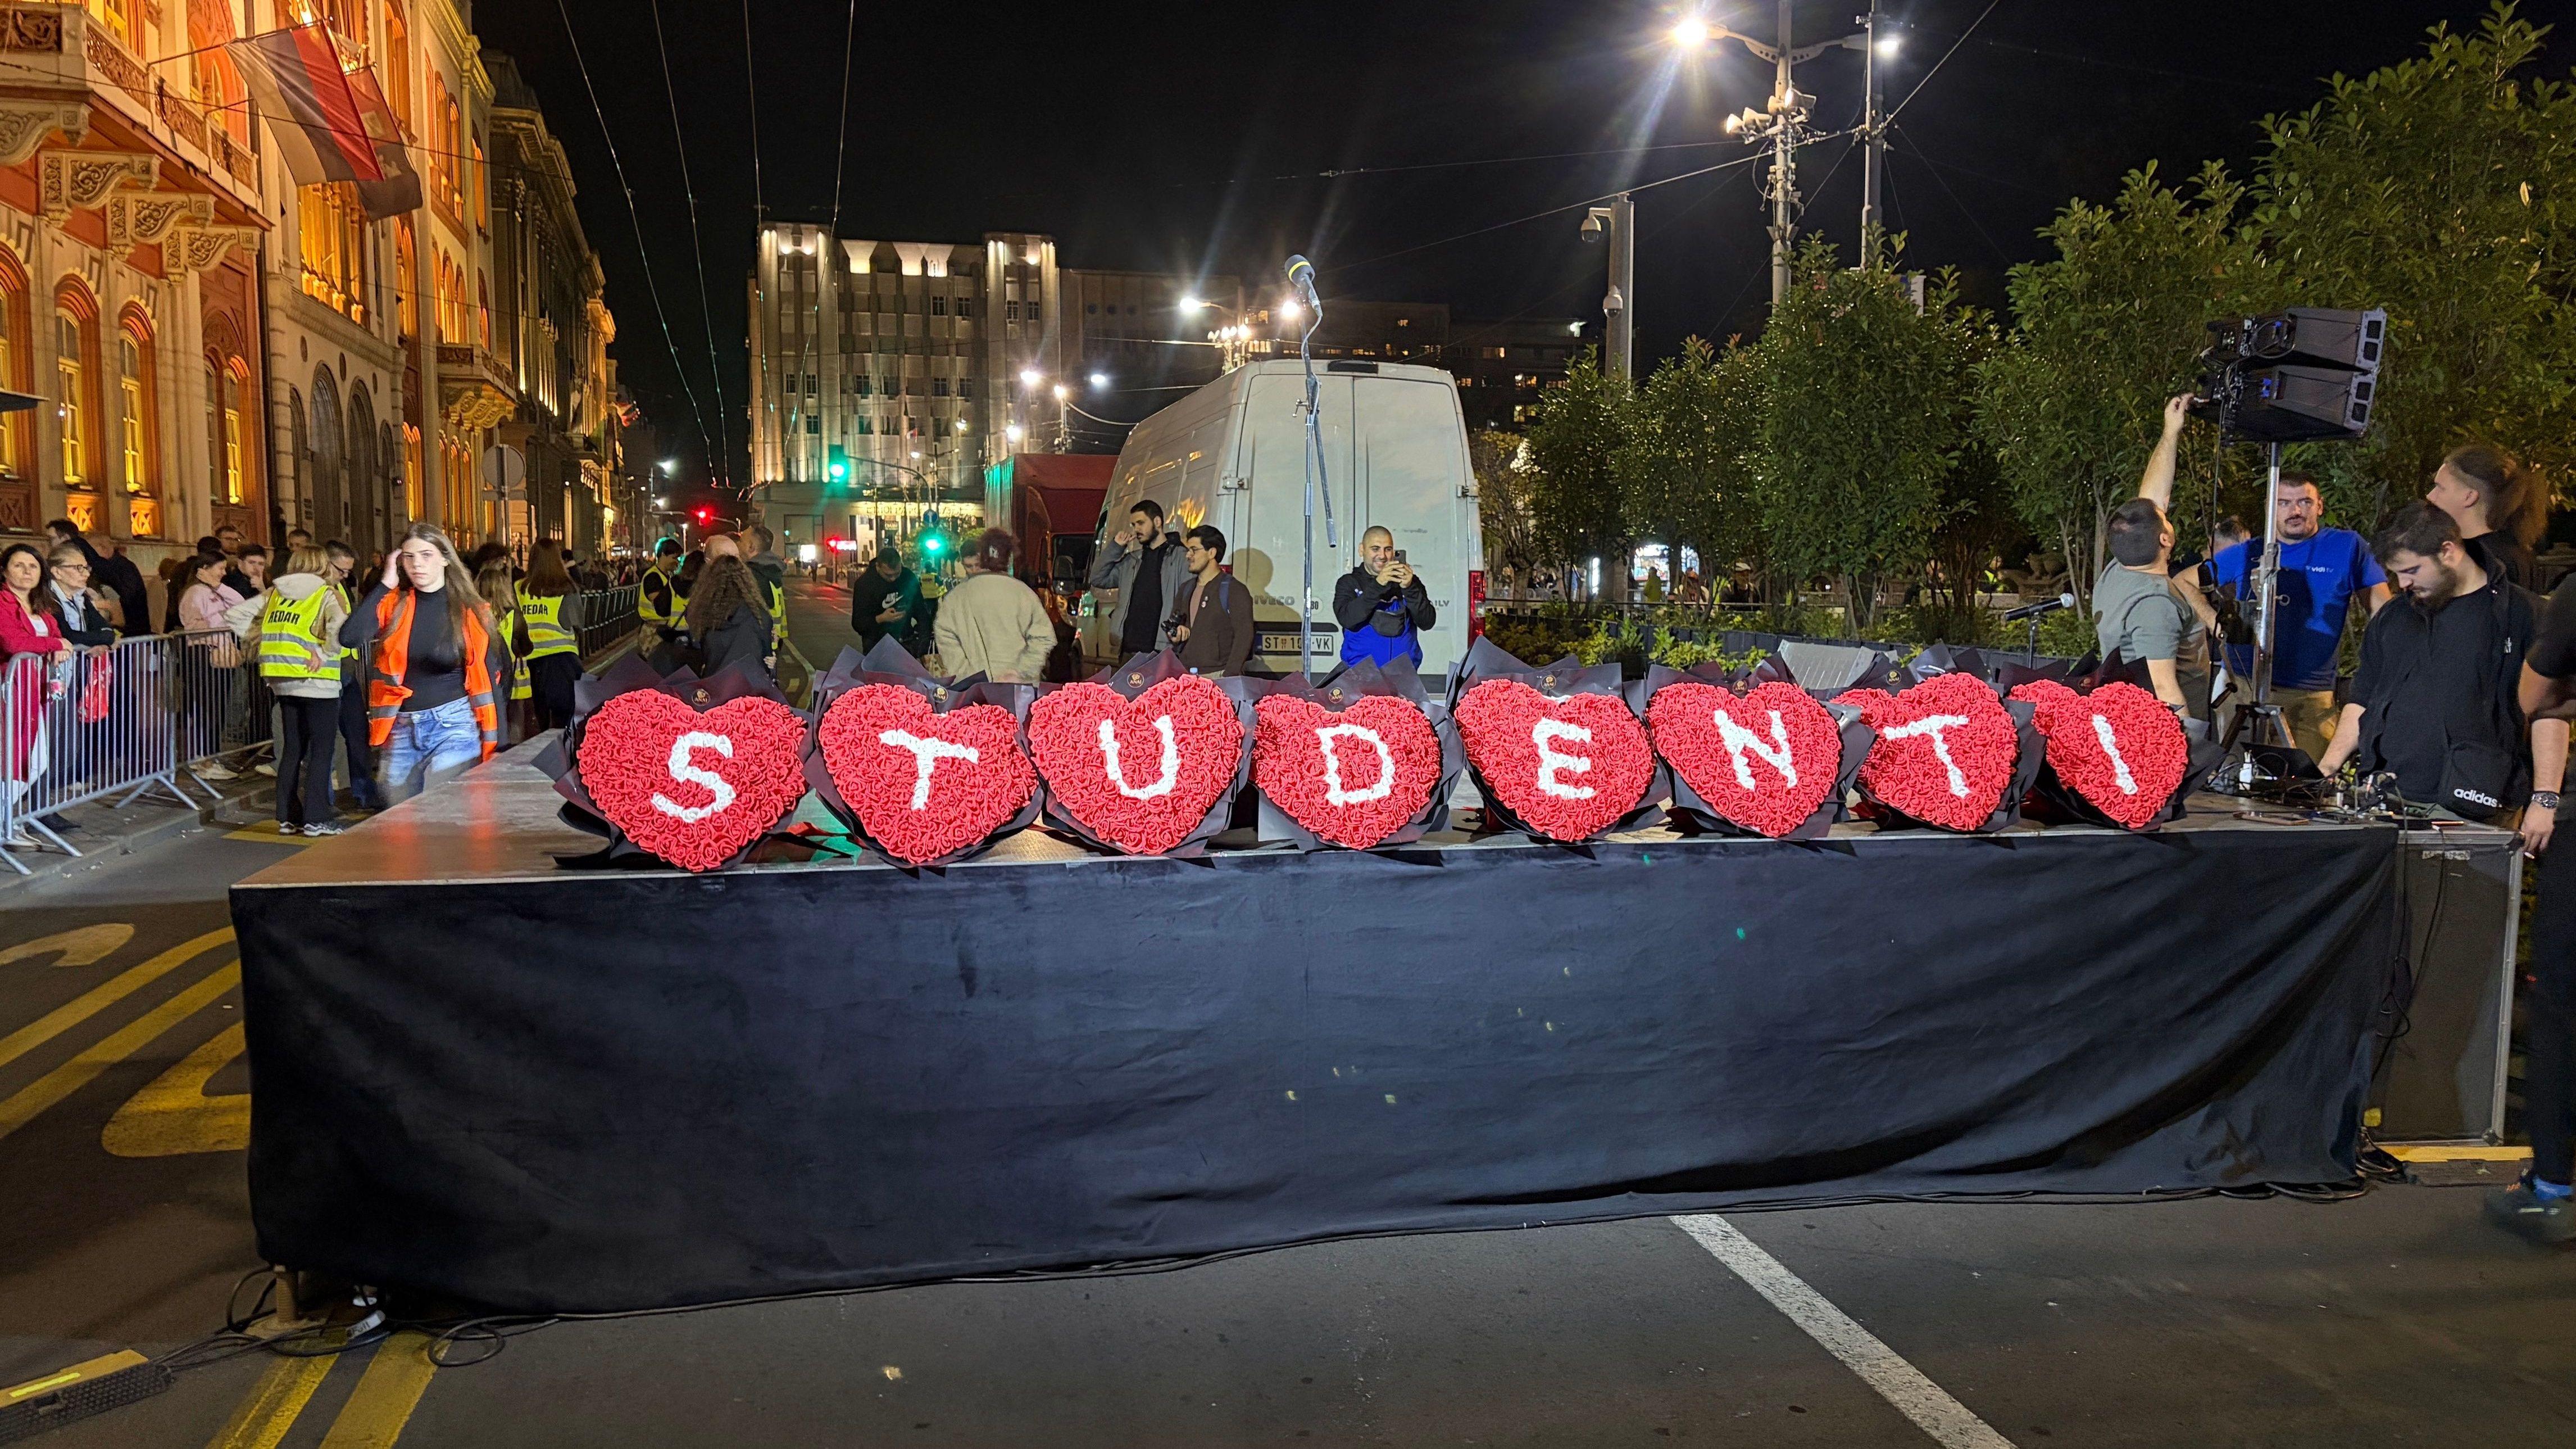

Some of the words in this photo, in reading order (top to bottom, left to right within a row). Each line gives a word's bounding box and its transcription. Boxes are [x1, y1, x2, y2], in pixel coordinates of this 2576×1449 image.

[1254, 595, 1295, 606] IVECO
[521, 603, 548, 616] REDAR
[1265, 637, 1279, 649] ST
[2454, 788, 2498, 808] adidas
